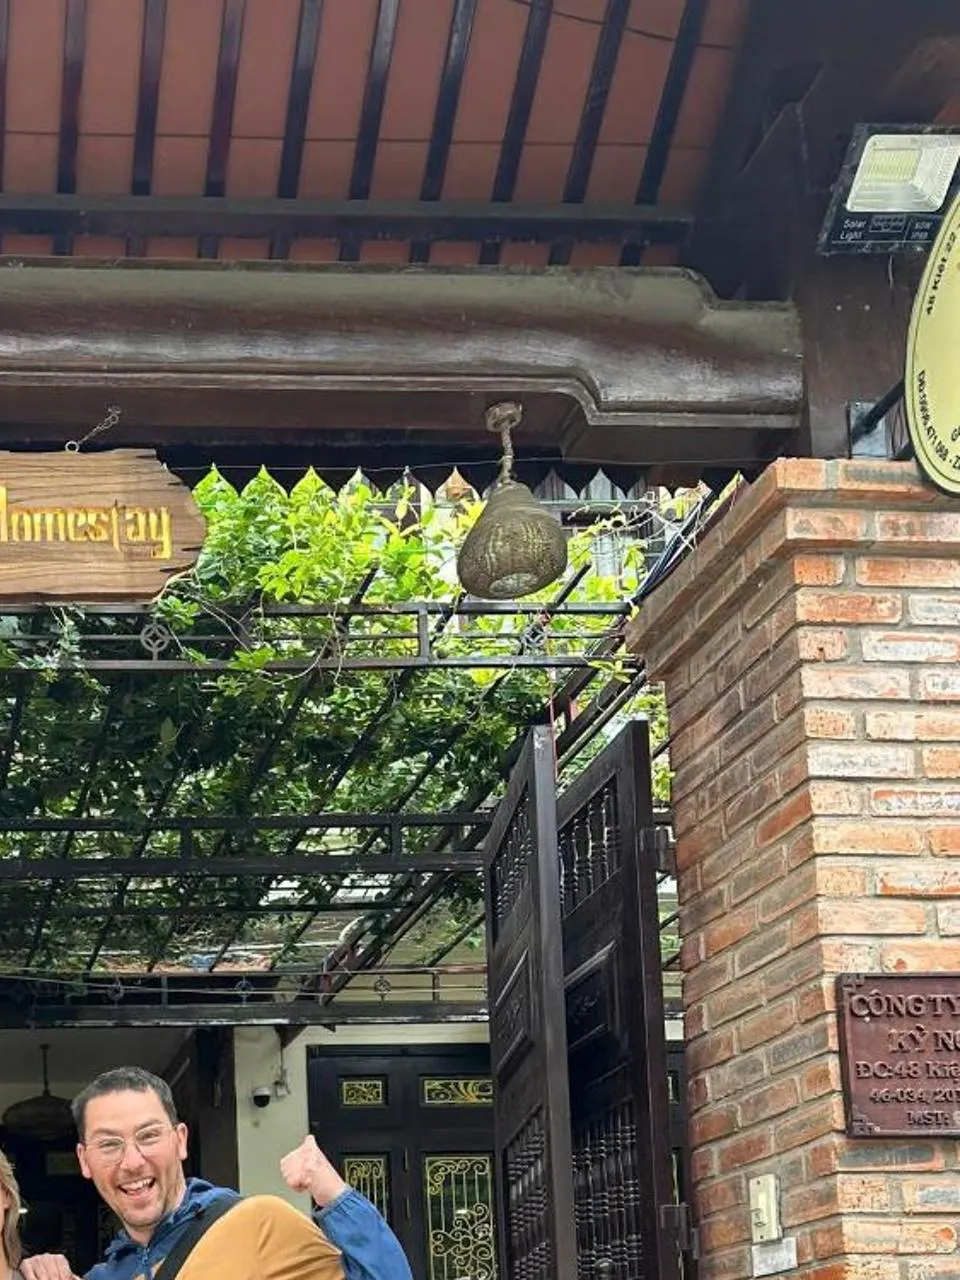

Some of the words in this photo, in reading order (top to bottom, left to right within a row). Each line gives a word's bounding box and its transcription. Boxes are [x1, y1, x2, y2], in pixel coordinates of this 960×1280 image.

[843, 219, 867, 229] Solar
[840, 231, 863, 242] Light
[851, 988, 926, 1017] CÔNG
